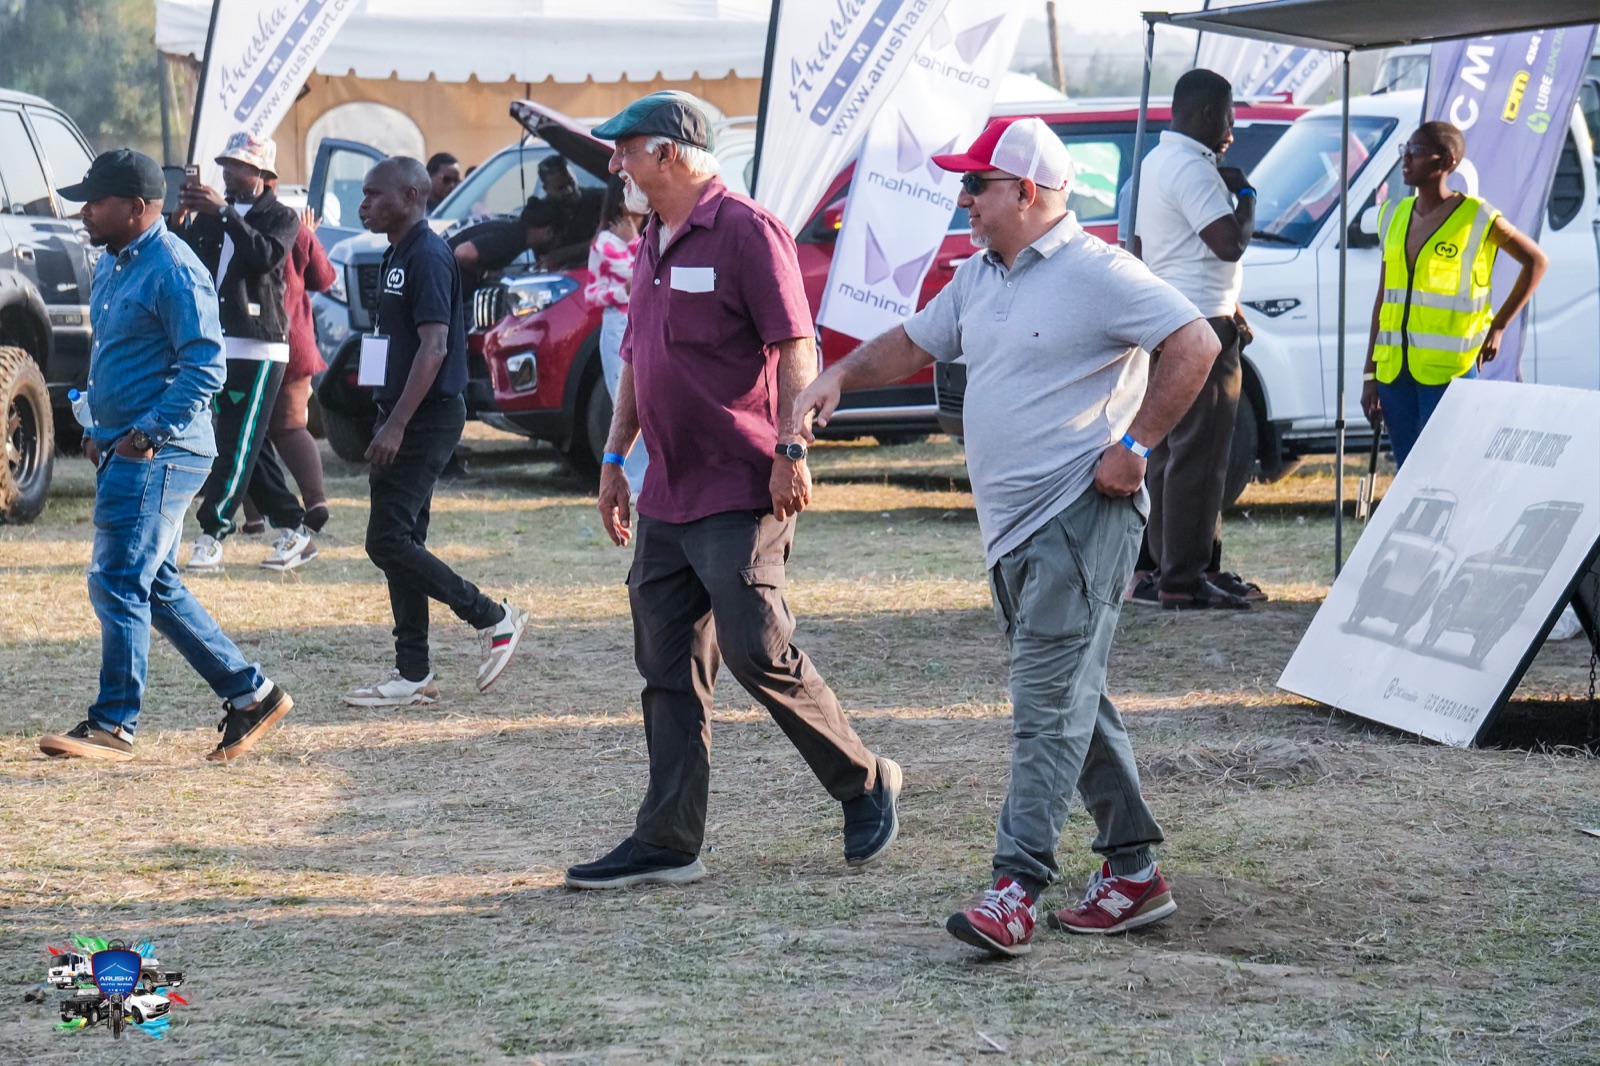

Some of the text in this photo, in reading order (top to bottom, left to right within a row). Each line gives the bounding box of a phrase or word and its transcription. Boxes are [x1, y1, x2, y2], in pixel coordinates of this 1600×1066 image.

[1535, 74, 1554, 111] LUBE
[868, 171, 954, 211] mahindra
[1434, 698, 1479, 724] GRENADIER
[1097, 890, 1134, 918] N
[1006, 917, 1027, 944] N
